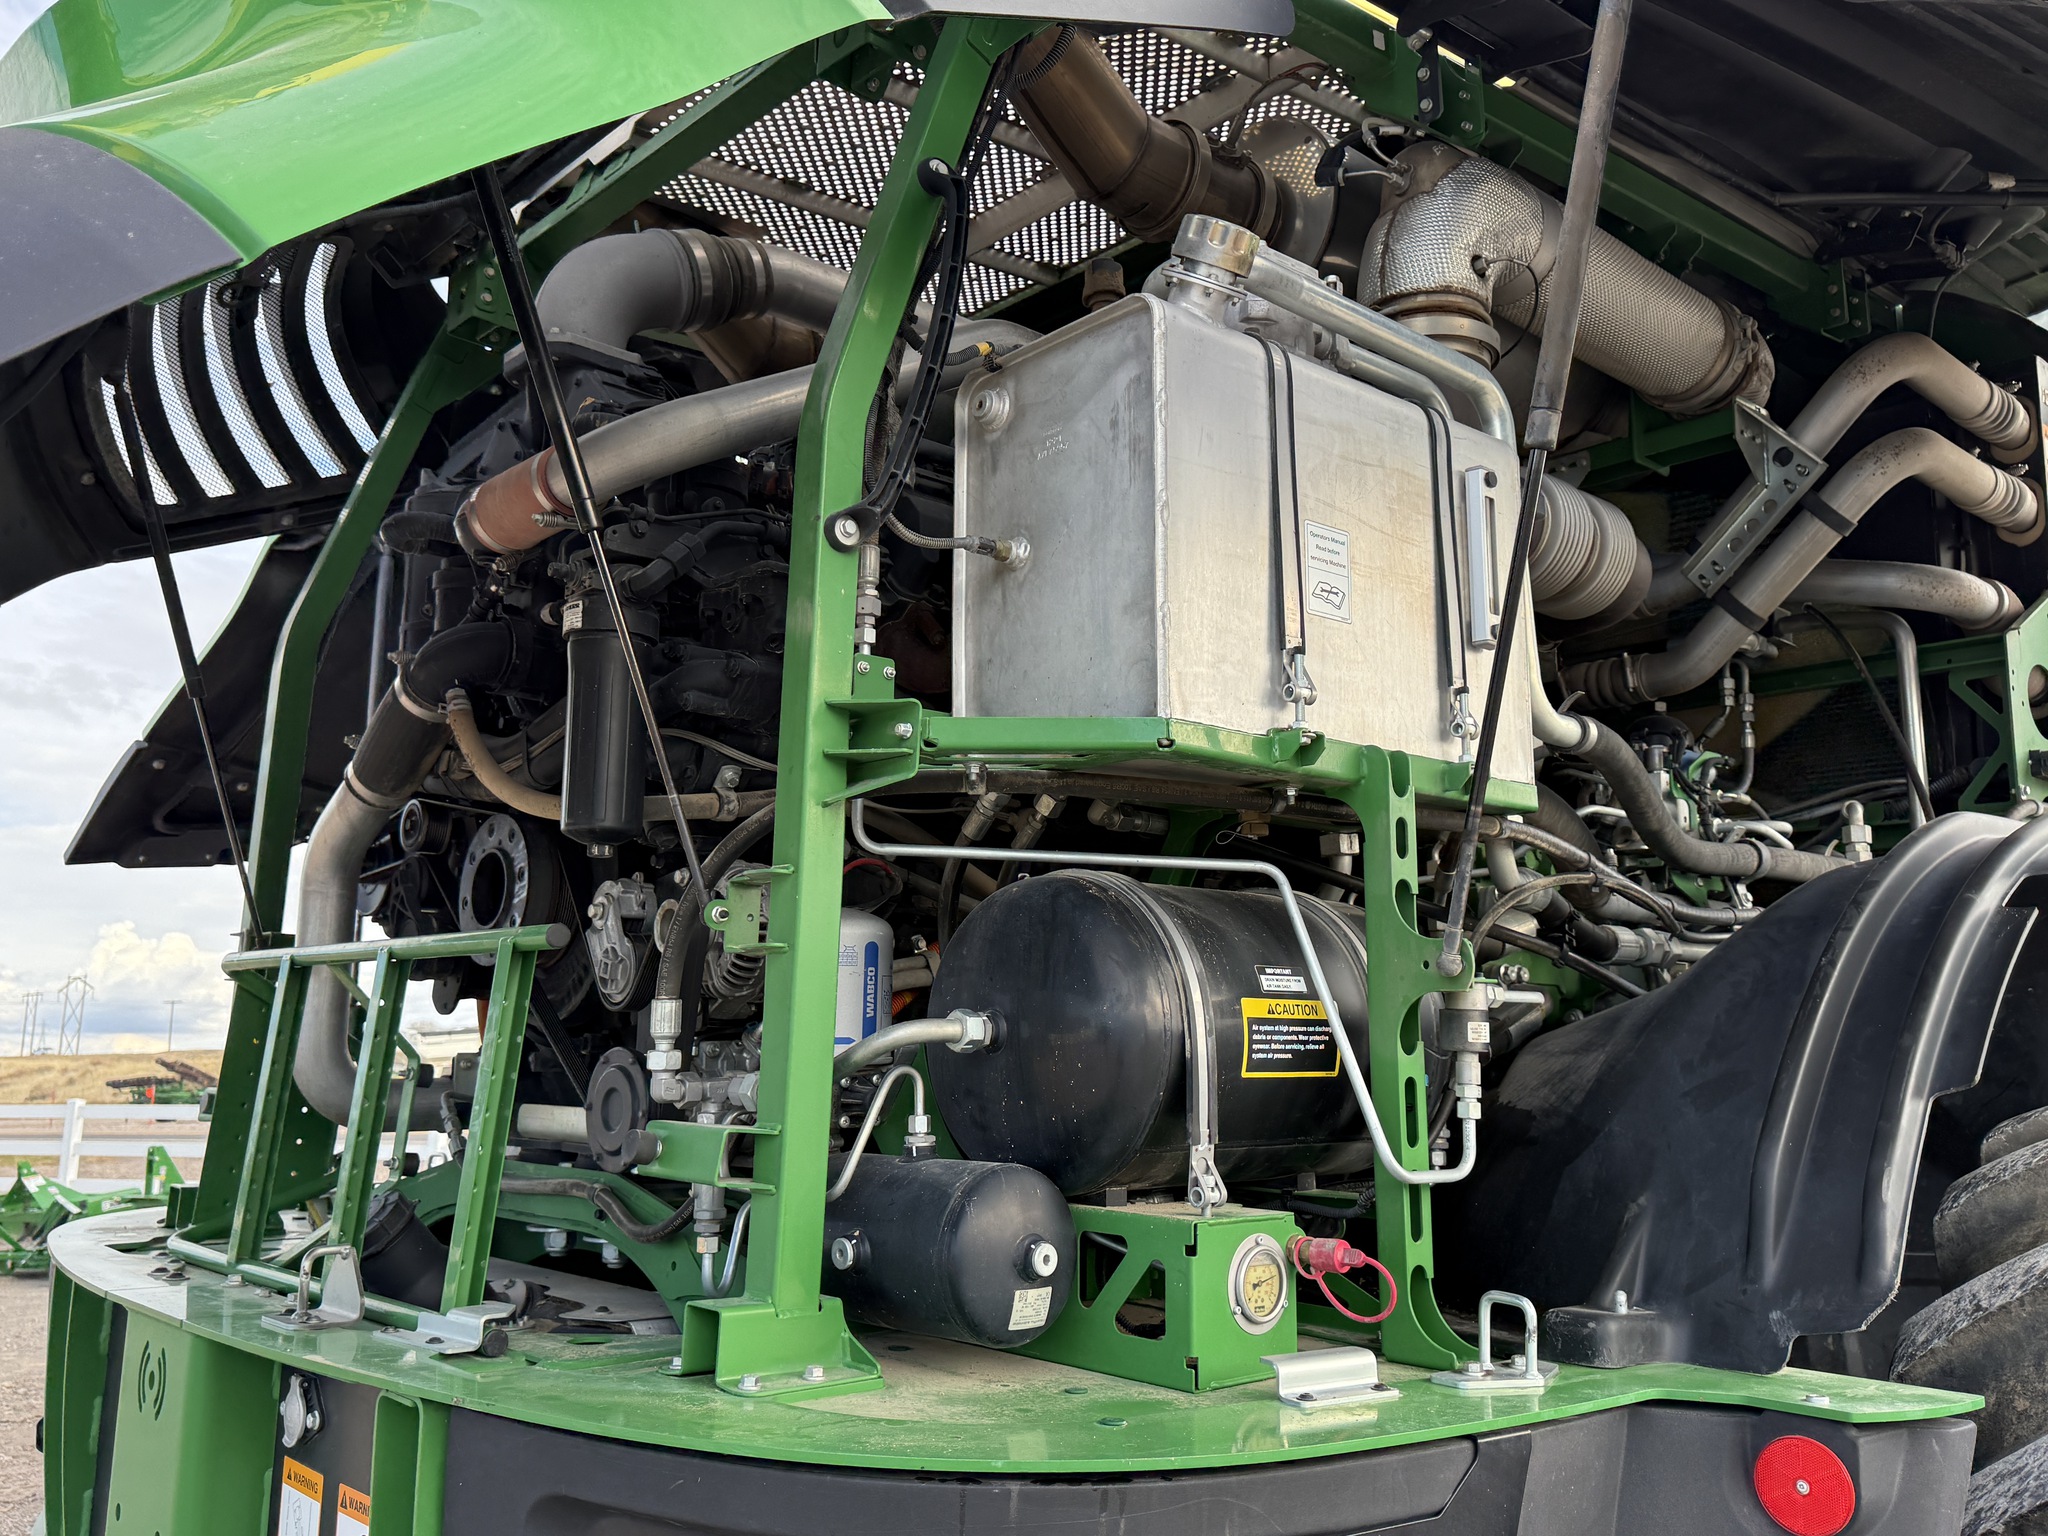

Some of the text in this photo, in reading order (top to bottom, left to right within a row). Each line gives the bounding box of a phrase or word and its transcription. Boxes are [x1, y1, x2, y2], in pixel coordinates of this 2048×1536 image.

[1310, 530, 1346, 546] Operators Manual
[1316, 544, 1340, 556] Read before
[1310, 555, 1346, 569] servicing Machine
[866, 966, 876, 1018] WABCO
[1275, 1003, 1318, 1016] CAUTION
[1285, 1043, 1305, 1051] servicing,
[293, 1470, 318, 1494] WARNING
[349, 1496, 370, 1517] WARNI
